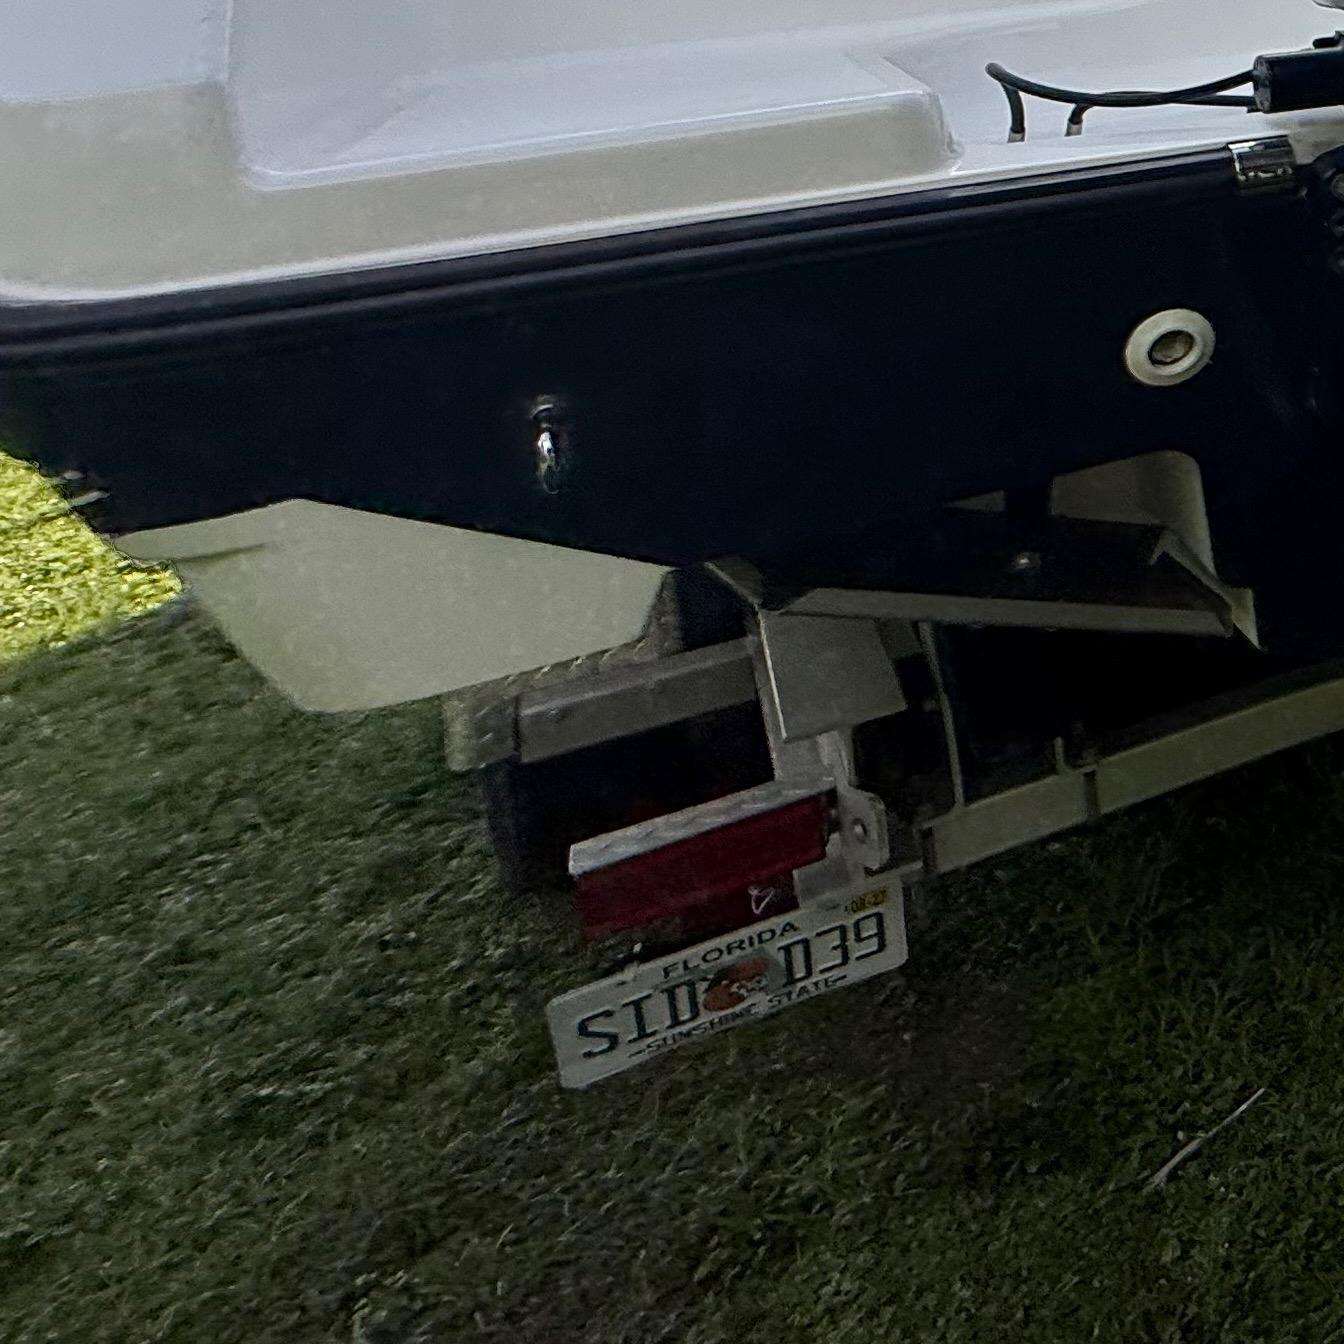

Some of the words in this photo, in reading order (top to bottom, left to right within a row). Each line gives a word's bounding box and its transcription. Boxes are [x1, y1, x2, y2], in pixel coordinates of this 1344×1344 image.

[662, 922, 799, 979] FLORIDA
[646, 1003, 754, 1053] SUNSHINE
[768, 978, 835, 1006] STATE
